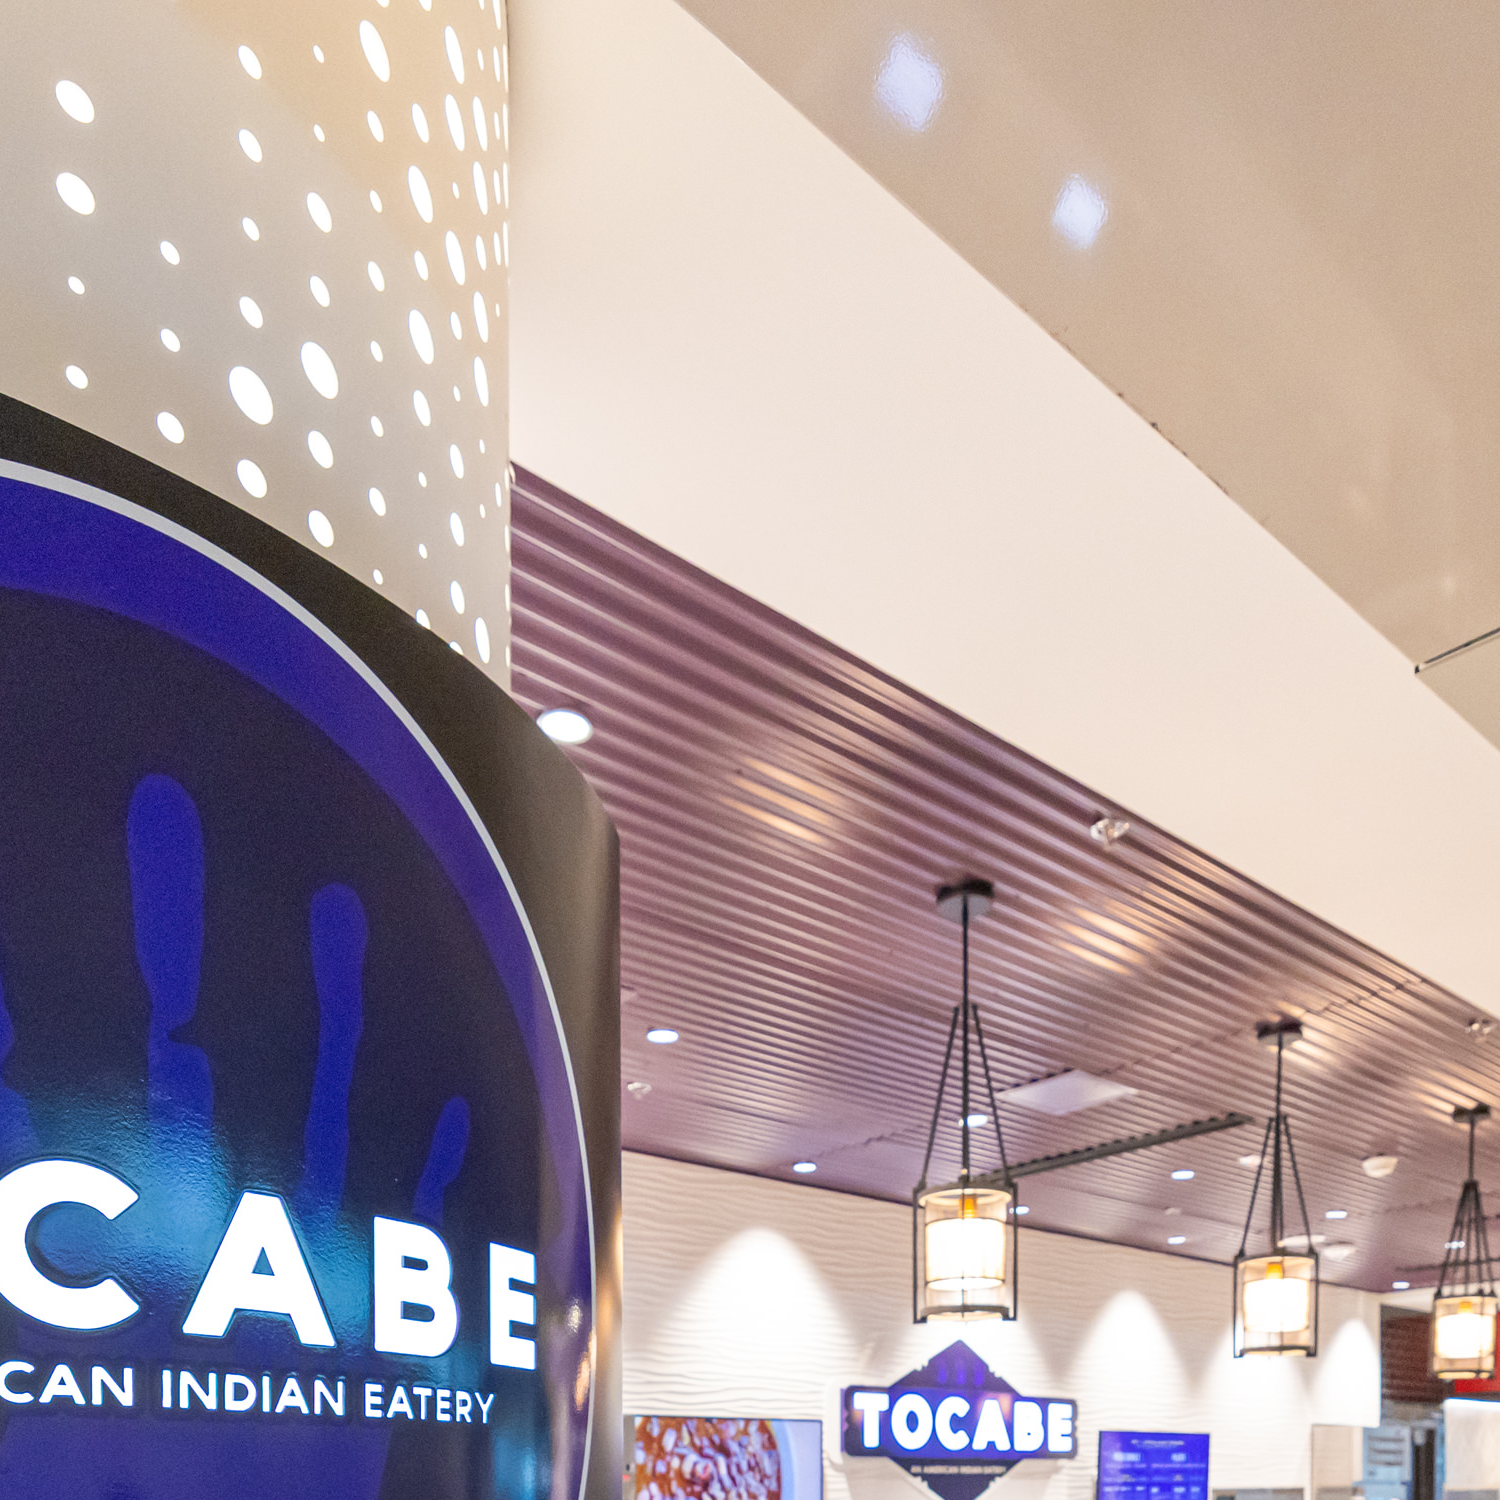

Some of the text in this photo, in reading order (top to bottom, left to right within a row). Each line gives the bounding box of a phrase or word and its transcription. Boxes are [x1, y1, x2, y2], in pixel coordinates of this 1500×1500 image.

[161, 1368, 347, 1417] INDIAN
[363, 1381, 496, 1426] EATERY
[853, 1391, 1074, 1453] TOCABE
